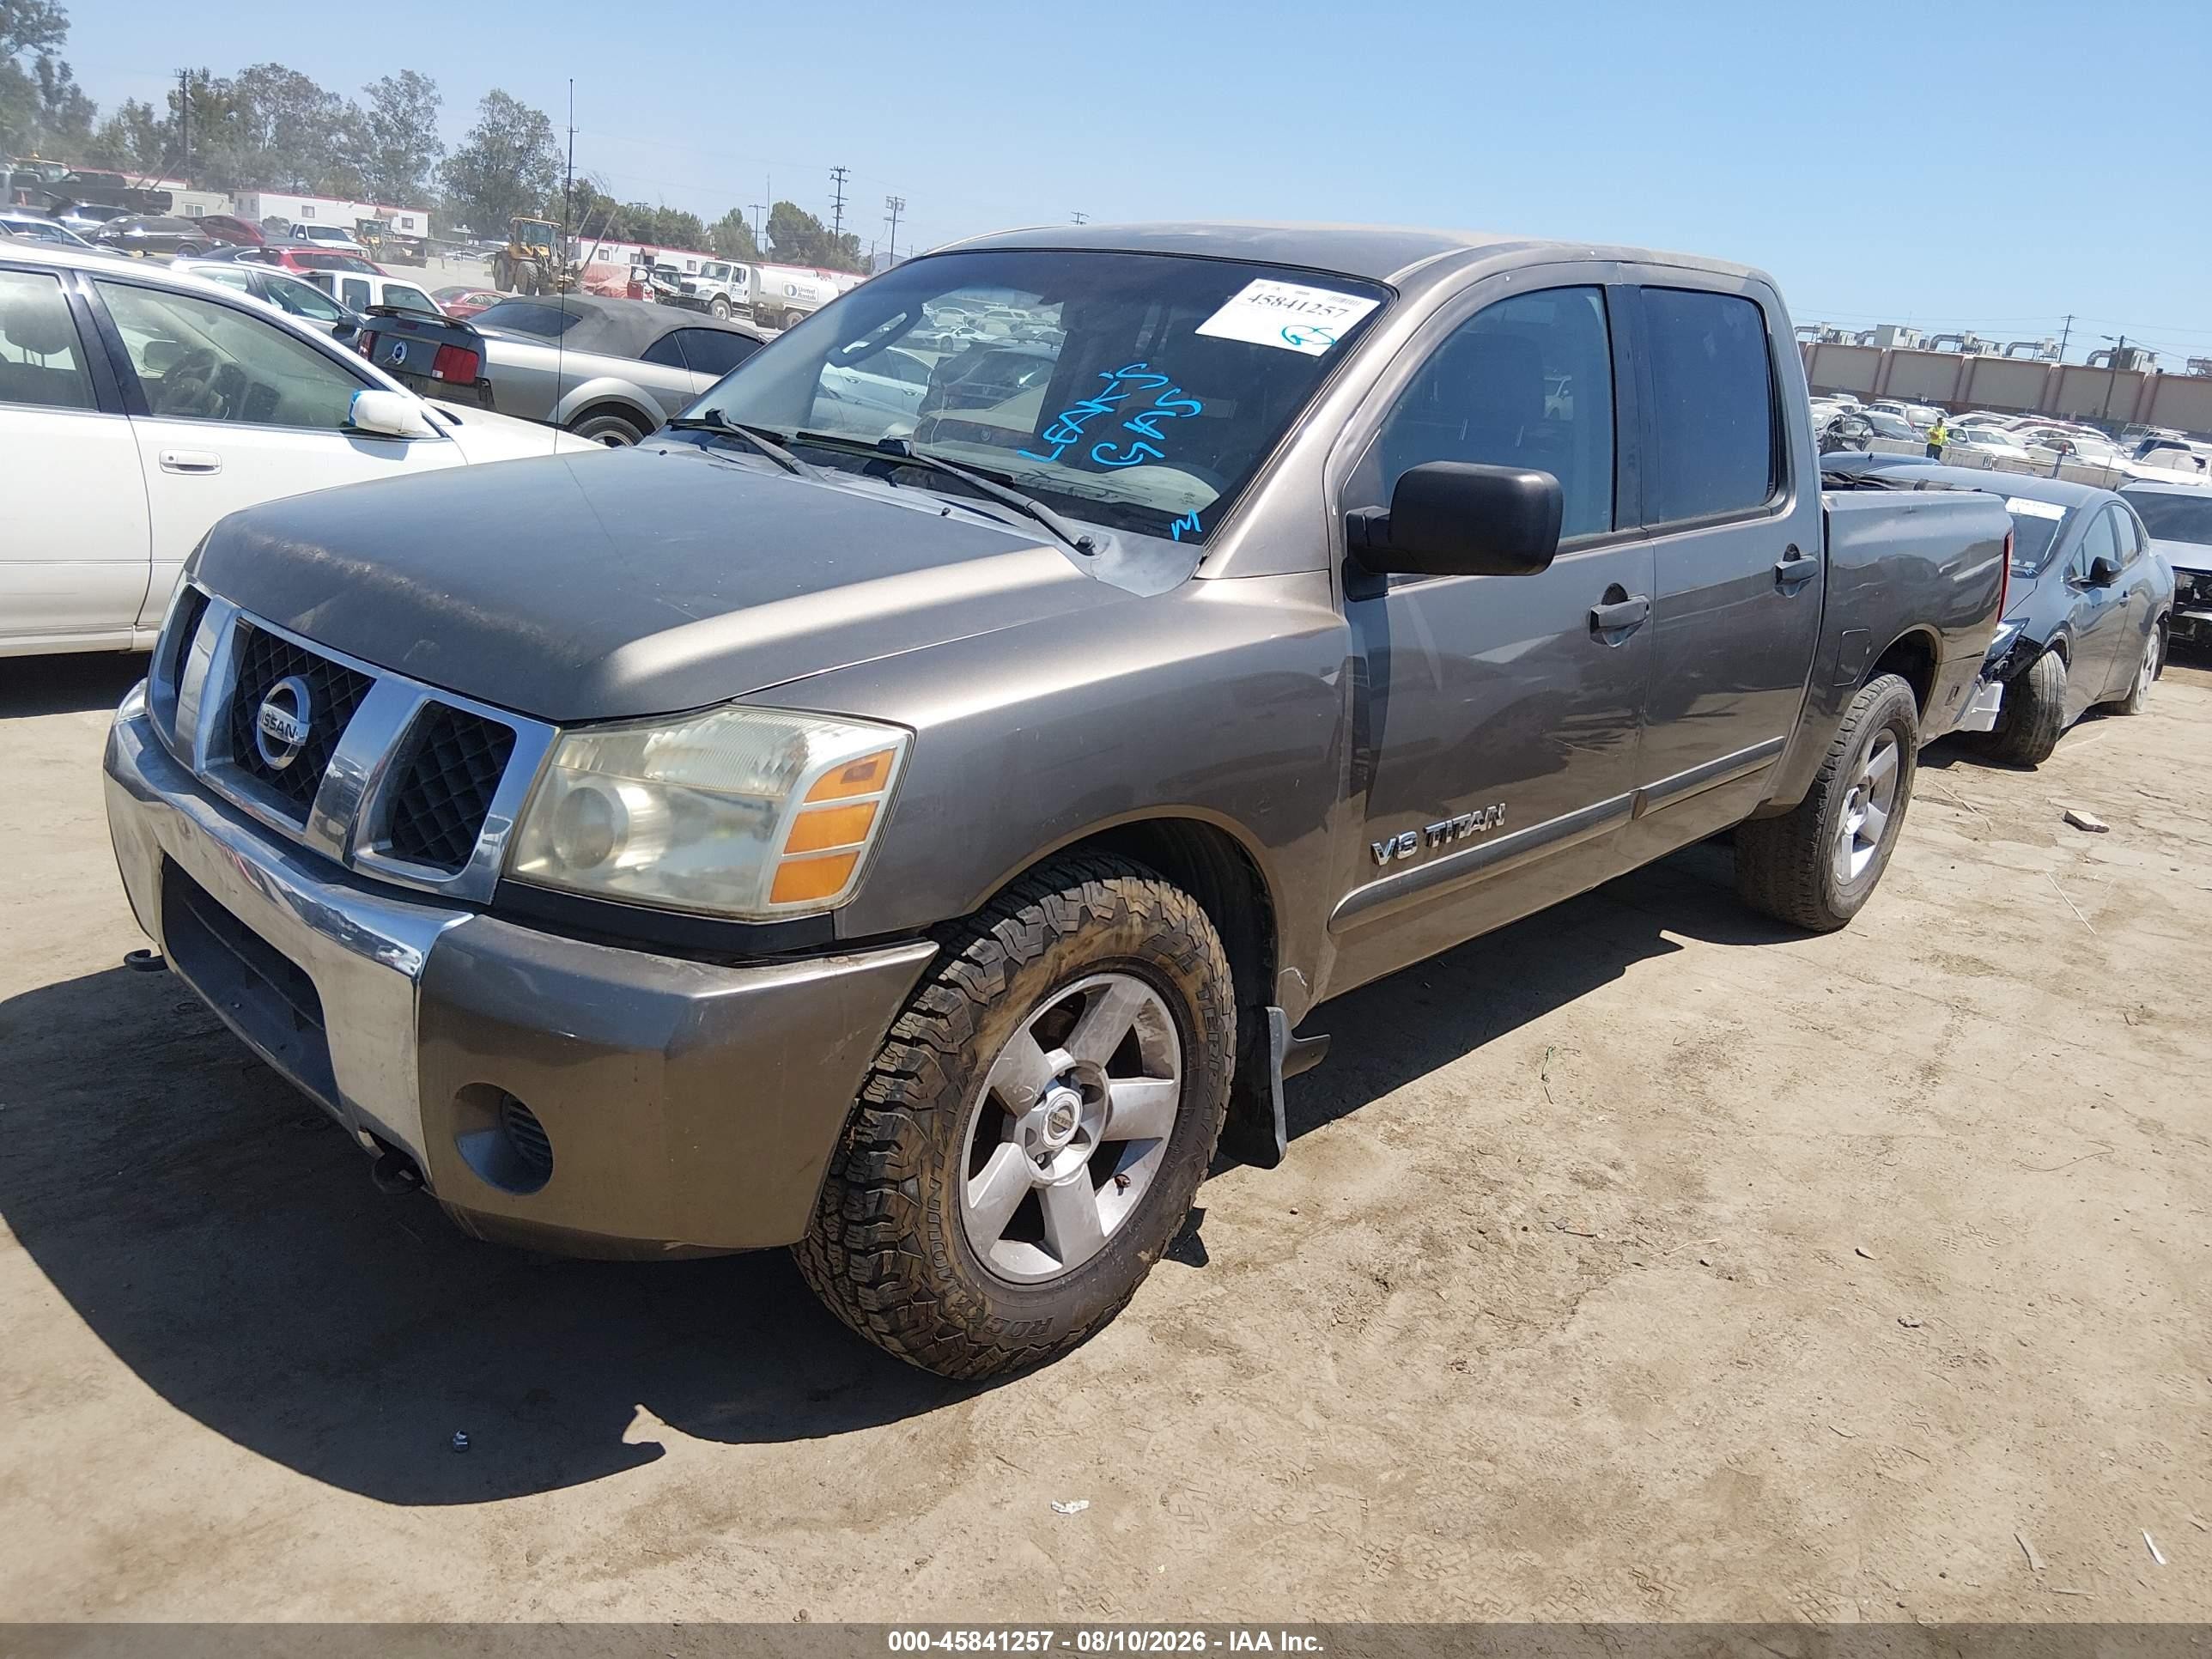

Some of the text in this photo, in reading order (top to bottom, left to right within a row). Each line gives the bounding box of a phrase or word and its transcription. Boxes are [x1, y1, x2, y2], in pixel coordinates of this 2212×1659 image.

[1246, 293, 1351, 319] 45841257
[1091, 388, 1202, 465] GAS
[260, 710, 298, 740] ISSAN
[1370, 802, 1506, 866] V8 TITAN
